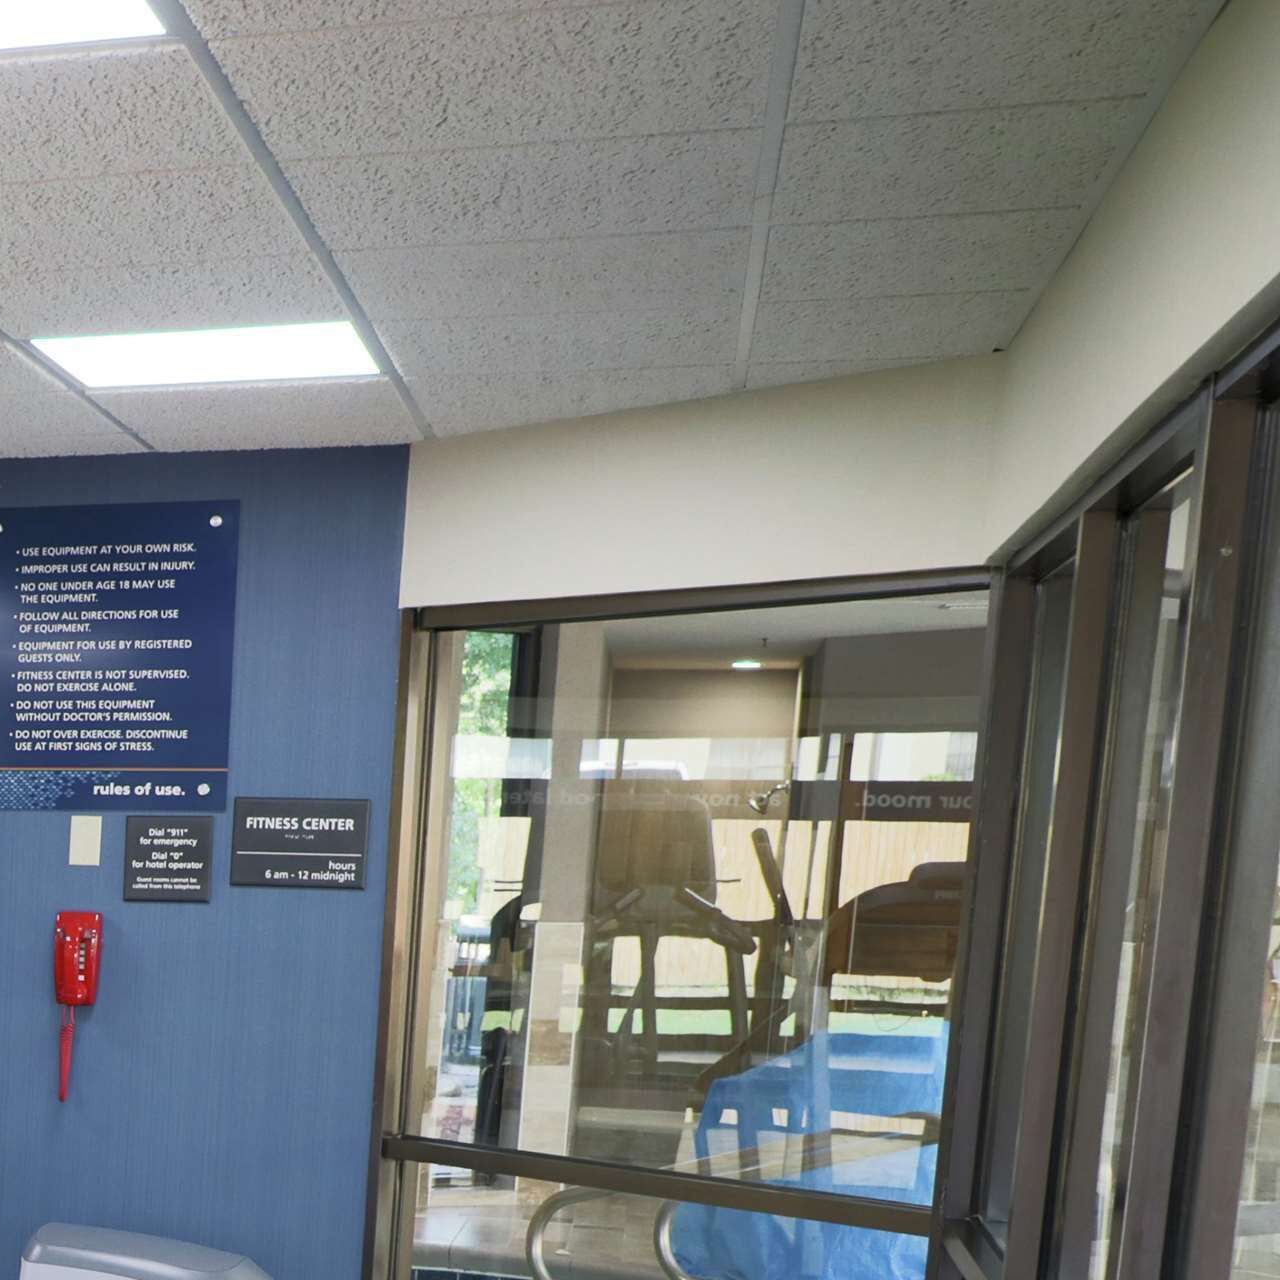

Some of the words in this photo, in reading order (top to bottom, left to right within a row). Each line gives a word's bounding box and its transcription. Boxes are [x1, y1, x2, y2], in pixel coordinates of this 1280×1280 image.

[22, 547, 39, 557] USE
[42, 546, 98, 556] EQUIPMENT
[99, 545, 113, 554] AT
[115, 544, 143, 554] YOUR
[144, 543, 171, 553] OWN
[172, 543, 197, 553] RISK.
[21, 564, 69, 574] IMPROPER
[70, 563, 88, 573] USE
[90, 563, 111, 573] CAN
[112, 562, 147, 572] RESULT
[148, 562, 159, 571] IN
[160, 561, 196, 571] INJURY.
[20, 582, 36, 592] NO
[37, 582, 58, 591] ONE
[60, 581, 94, 591] UNDER
[95, 580, 116, 590] AGE
[119, 580, 130, 590] 18
[132, 580, 155, 589] MAY
[157, 579, 176, 589] USE
[20, 594, 38, 604] THE
[40, 593, 98, 604] EQUIPMENT.
[19, 612, 60, 621] FOLLOW
[61, 611, 79, 621] ALL
[81, 610, 137, 620] DIRECTIONS
[139, 609, 158, 619] FOR
[160, 609, 179, 619] USE
[19, 624, 32, 634] OF
[34, 623, 91, 633] EQUIPMENT.
[18, 641, 75, 651] EQUIPMENT
[76, 640, 96, 650] FOR
[98, 640, 116, 650] USE
[118, 640, 132, 650] BY
[134, 639, 193, 649] REGISTERED
[18, 653, 53, 663] GUESTS
[54, 653, 82, 663] ONLY.
[17, 670, 54, 680] FITNESS
[55, 670, 92, 680] CENTER
[94, 670, 103, 680] IS
[105, 670, 127, 679] NOT
[129, 669, 190, 679] SUPERVISED.
[16, 683, 33, 692] DO
[33, 682, 55, 692] NOT
[56, 682, 99, 692] EXERCISE
[101, 682, 137, 692] ALONE.
[16, 700, 32, 710] DO
[33, 700, 54, 710] NOT
[55, 700, 74, 710] USE
[75, 700, 97, 709] THIS
[98, 699, 155, 710] EQUIPMENT
[15, 712, 61, 722] WITHOUT
[62, 712, 111, 722] DOCTOR'S
[112, 712, 173, 721] PERMISSION.
[15, 729, 30, 739] DO
[31, 729, 52, 739] NOT
[52, 729, 79, 739] OVER
[80, 729, 124, 739] EXERCISE.
[125, 729, 188, 739] DISCONTINUE
[15, 741, 32, 751] USE
[34, 741, 47, 751] AT
[48, 741, 73, 751] FIRST
[75, 741, 102, 751] SIGNS
[104, 741, 118, 751] OF
[119, 741, 154, 751] STRESS.
[93, 783, 131, 796] rules
[134, 782, 152, 796] of
[155, 785, 185, 796] use.
[246, 817, 299, 830] FITNESS
[302, 818, 354, 831] CENTER
[148, 828, 165, 837] Dial
[139, 836, 152, 845] for
[153, 838, 198, 847] emergency
[151, 851, 168, 860] Dial
[131, 860, 144, 869] for
[145, 860, 167, 869] hotel
[168, 862, 203, 870] operator
[328, 861, 356, 871] hours
[265, 869, 272, 879] 6
[273, 871, 289, 879] am
[298, 870, 309, 880] 12
[311, 871, 355, 883] midnight
